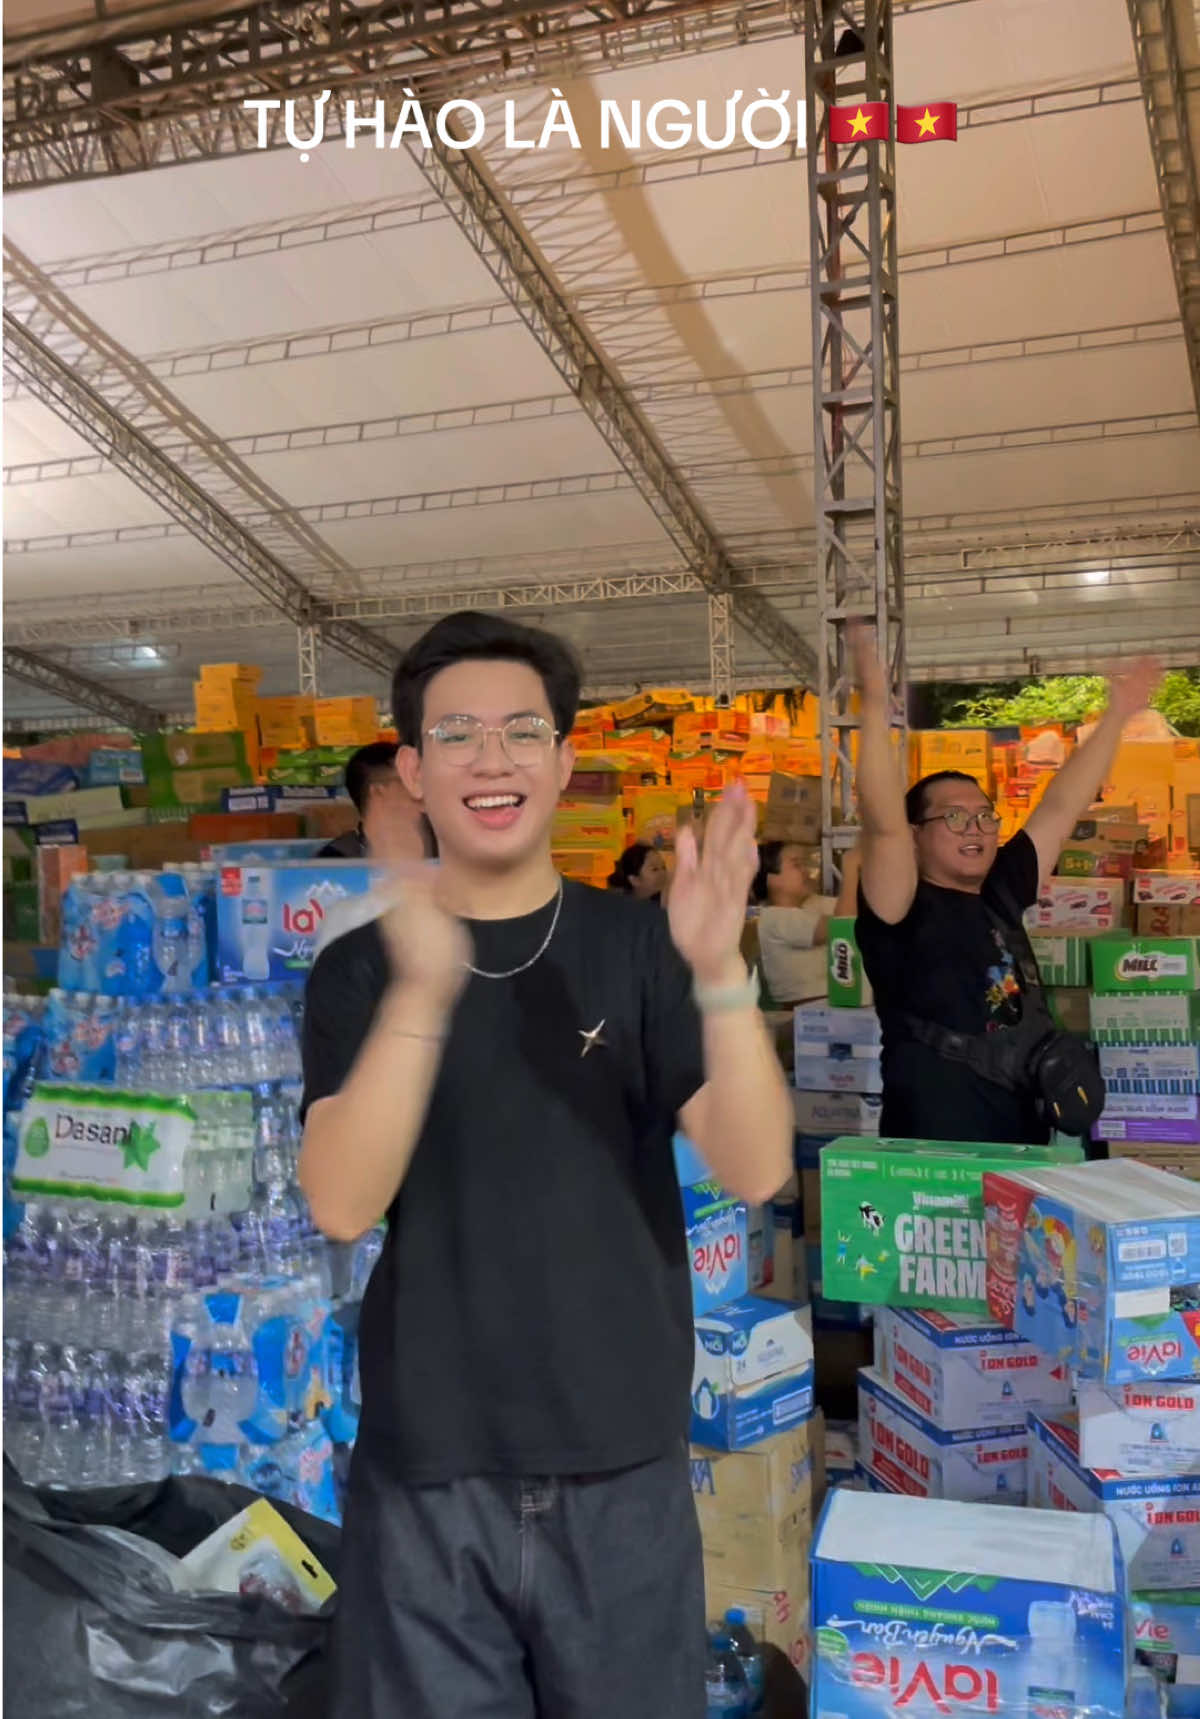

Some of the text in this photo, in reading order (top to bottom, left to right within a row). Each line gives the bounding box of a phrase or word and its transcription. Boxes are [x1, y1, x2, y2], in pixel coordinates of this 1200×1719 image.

[894, 1213, 986, 1258] GREEN
[899, 1255, 987, 1300] FARM
[1006, 1354, 1039, 1369] GOLD
[1155, 1395, 1195, 1410] GOLD
